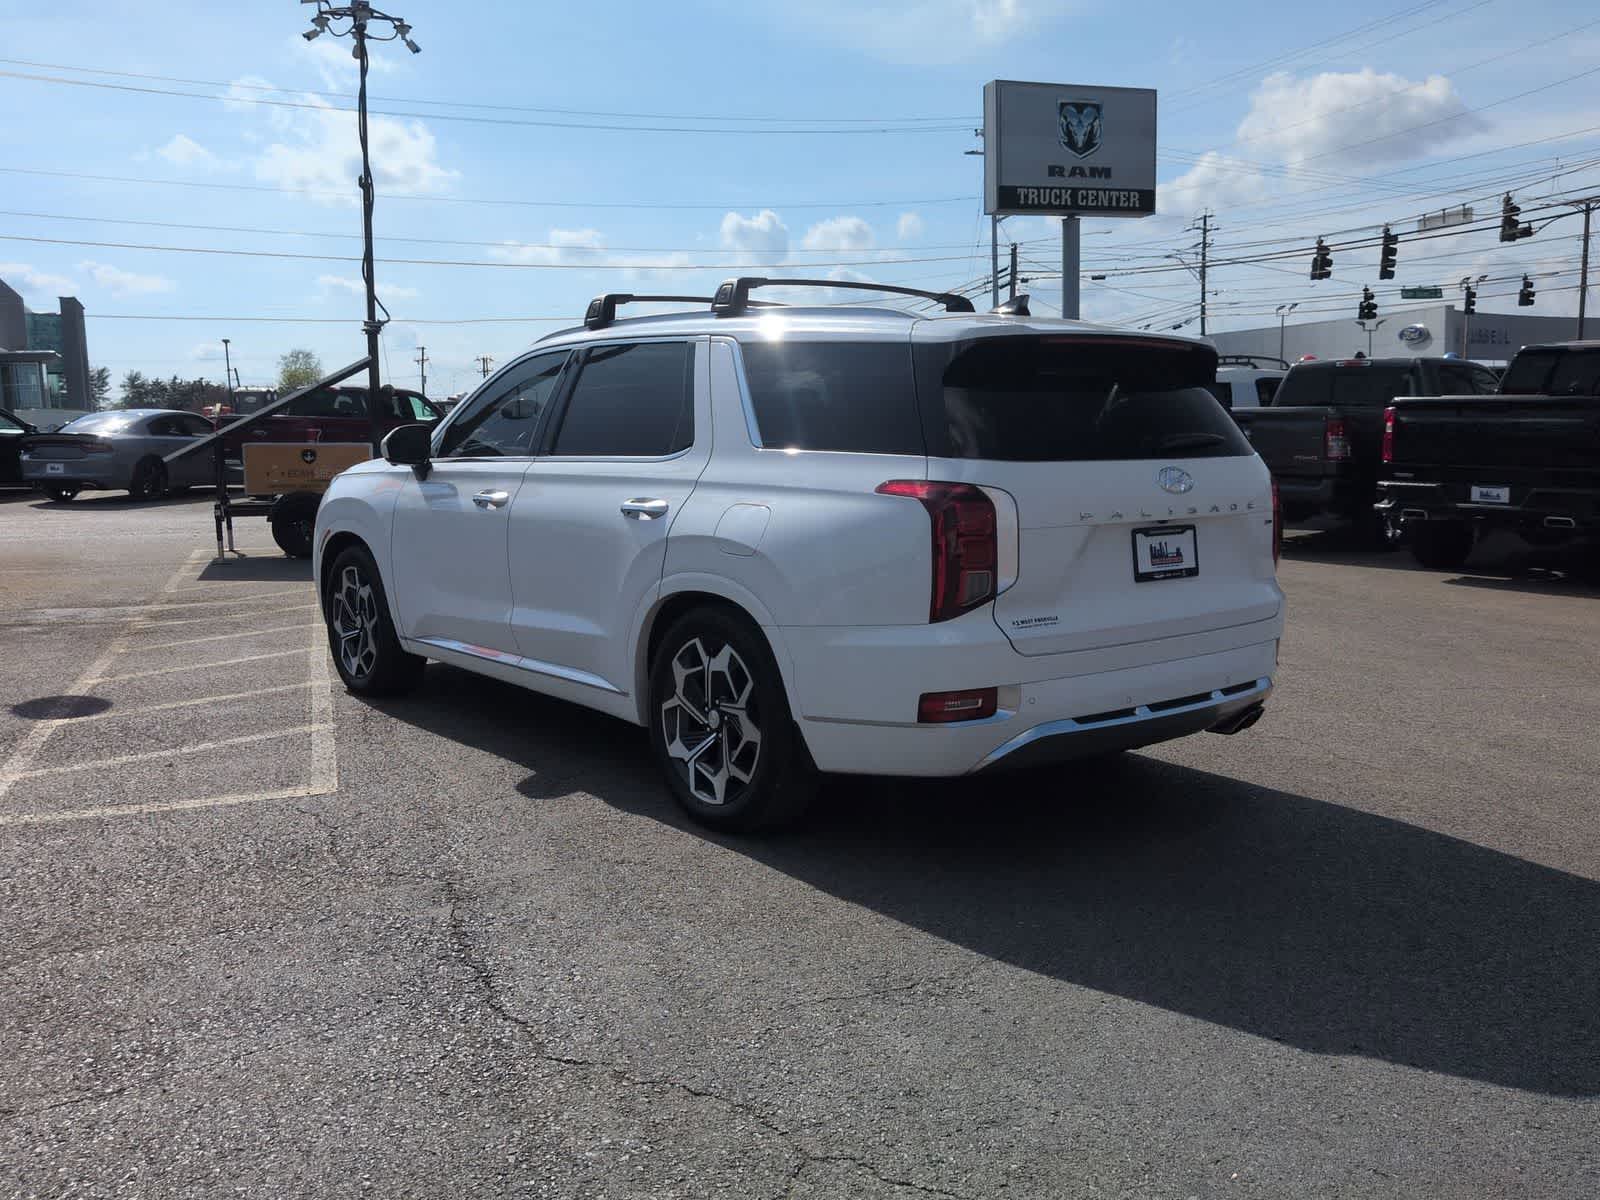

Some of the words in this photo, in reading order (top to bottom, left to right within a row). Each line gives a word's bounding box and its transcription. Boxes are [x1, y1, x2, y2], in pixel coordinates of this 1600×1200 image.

[1047, 165, 1112, 179] RAM
[1016, 187, 1073, 206] TRUCK
[1077, 189, 1140, 208] CENTER
